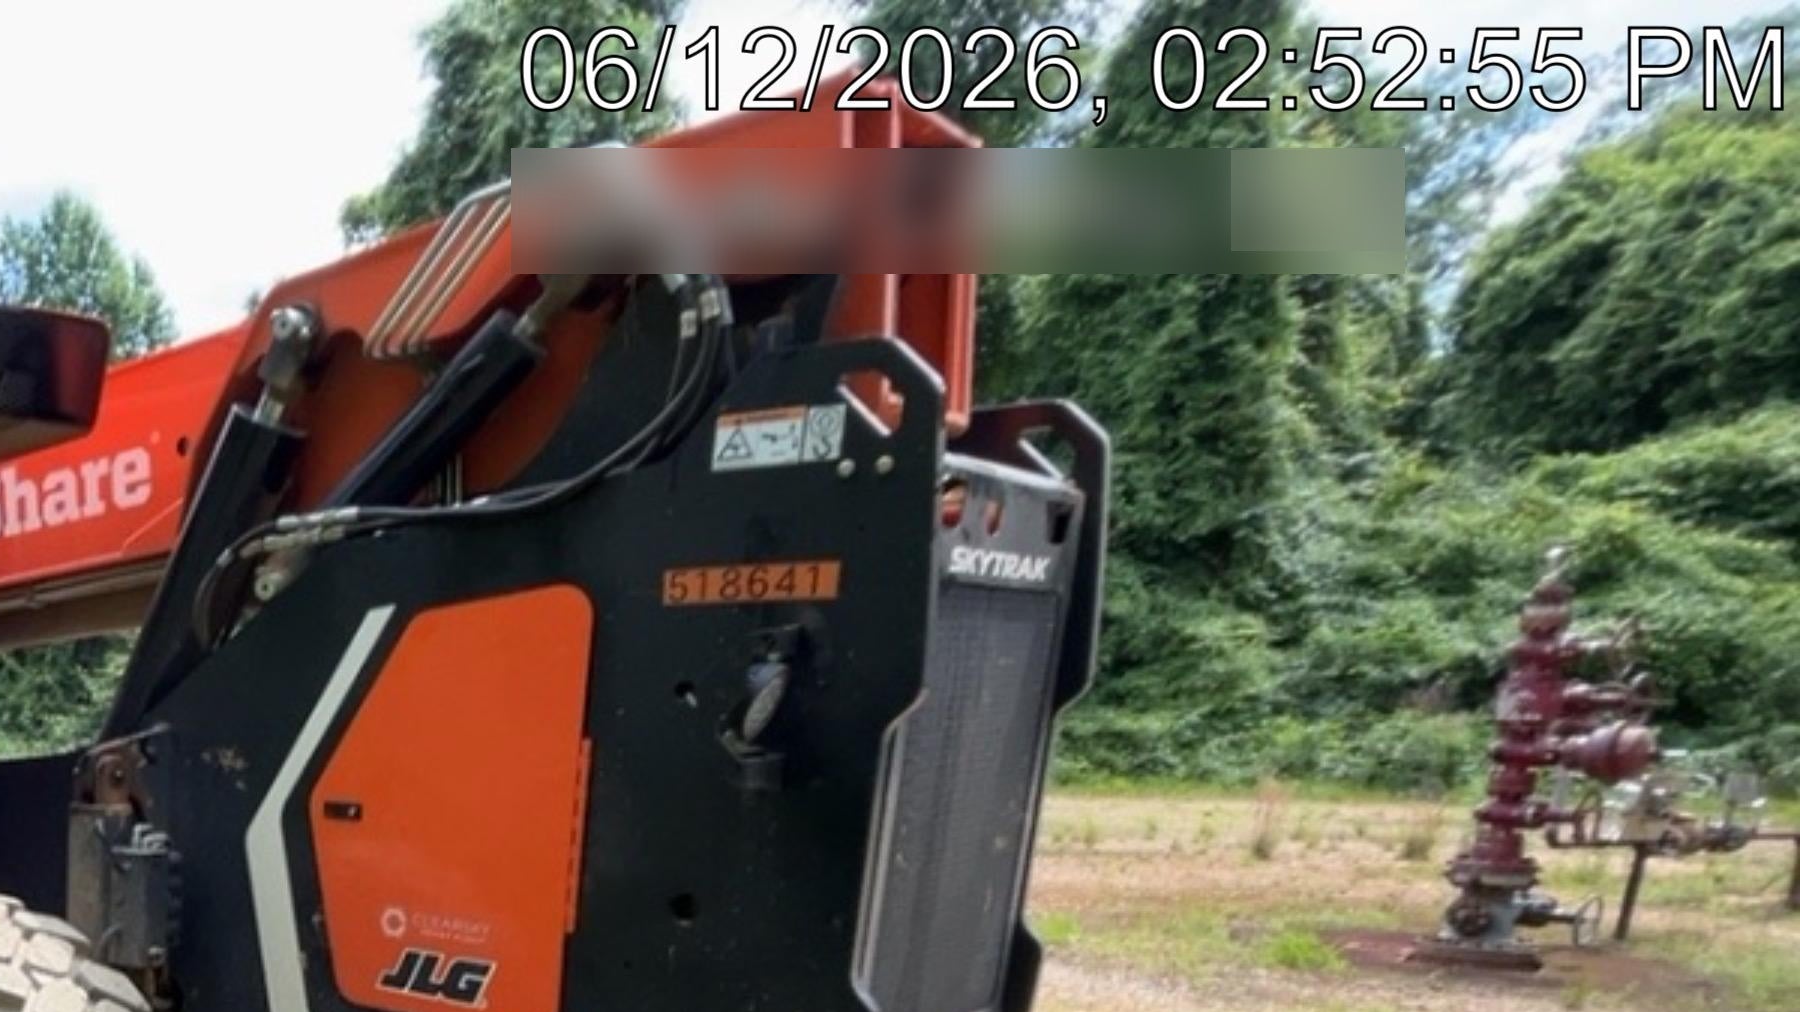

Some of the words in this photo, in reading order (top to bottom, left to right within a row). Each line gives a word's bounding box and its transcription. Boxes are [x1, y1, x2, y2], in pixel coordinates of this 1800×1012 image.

[948, 545, 1051, 581] SKYTRAK
[668, 564, 821, 601] 518641
[375, 947, 498, 1009] JLG
